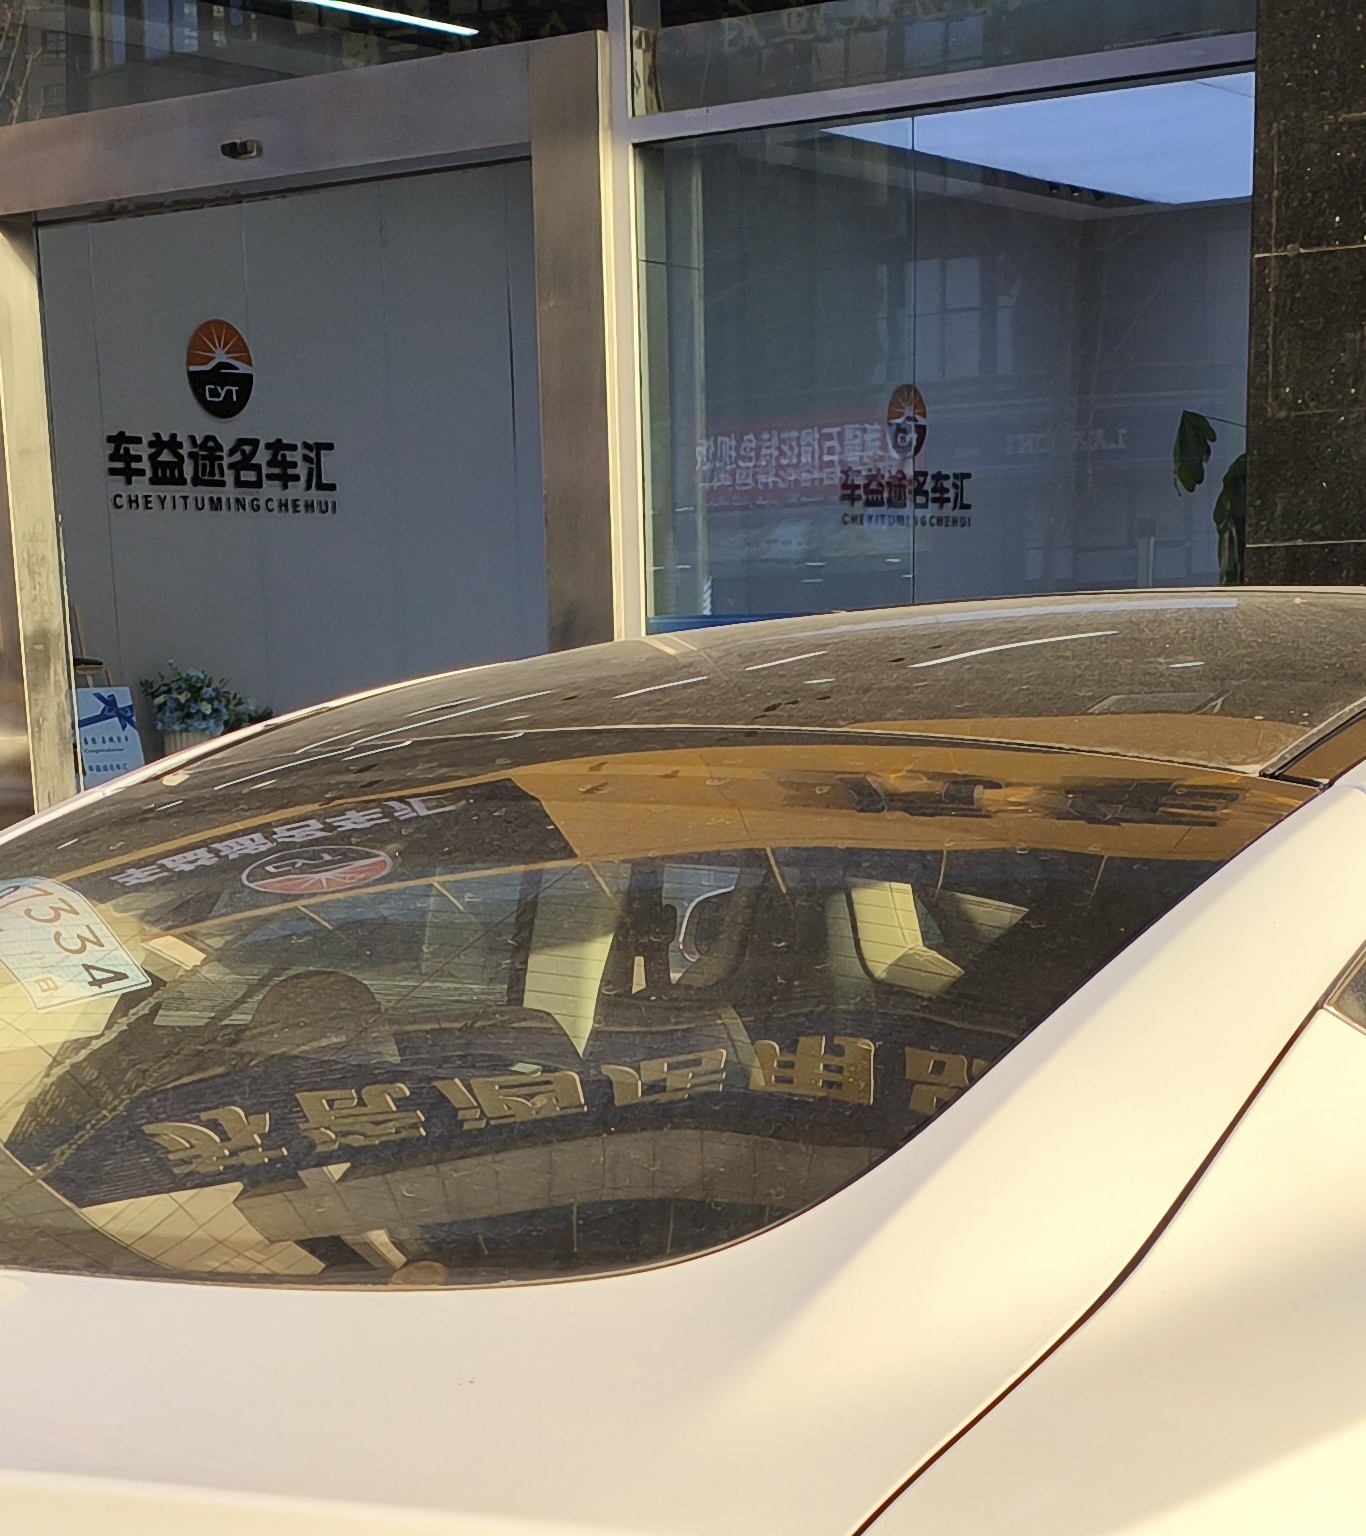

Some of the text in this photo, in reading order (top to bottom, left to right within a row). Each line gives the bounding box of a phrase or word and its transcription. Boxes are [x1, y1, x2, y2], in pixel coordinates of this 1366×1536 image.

[204, 385, 239, 402] CYT
[106, 430, 337, 491] 车益途名车汇
[112, 493, 338, 515] CHEYITUMINGCHEHUI
[840, 465, 972, 511] 车益途名车汇
